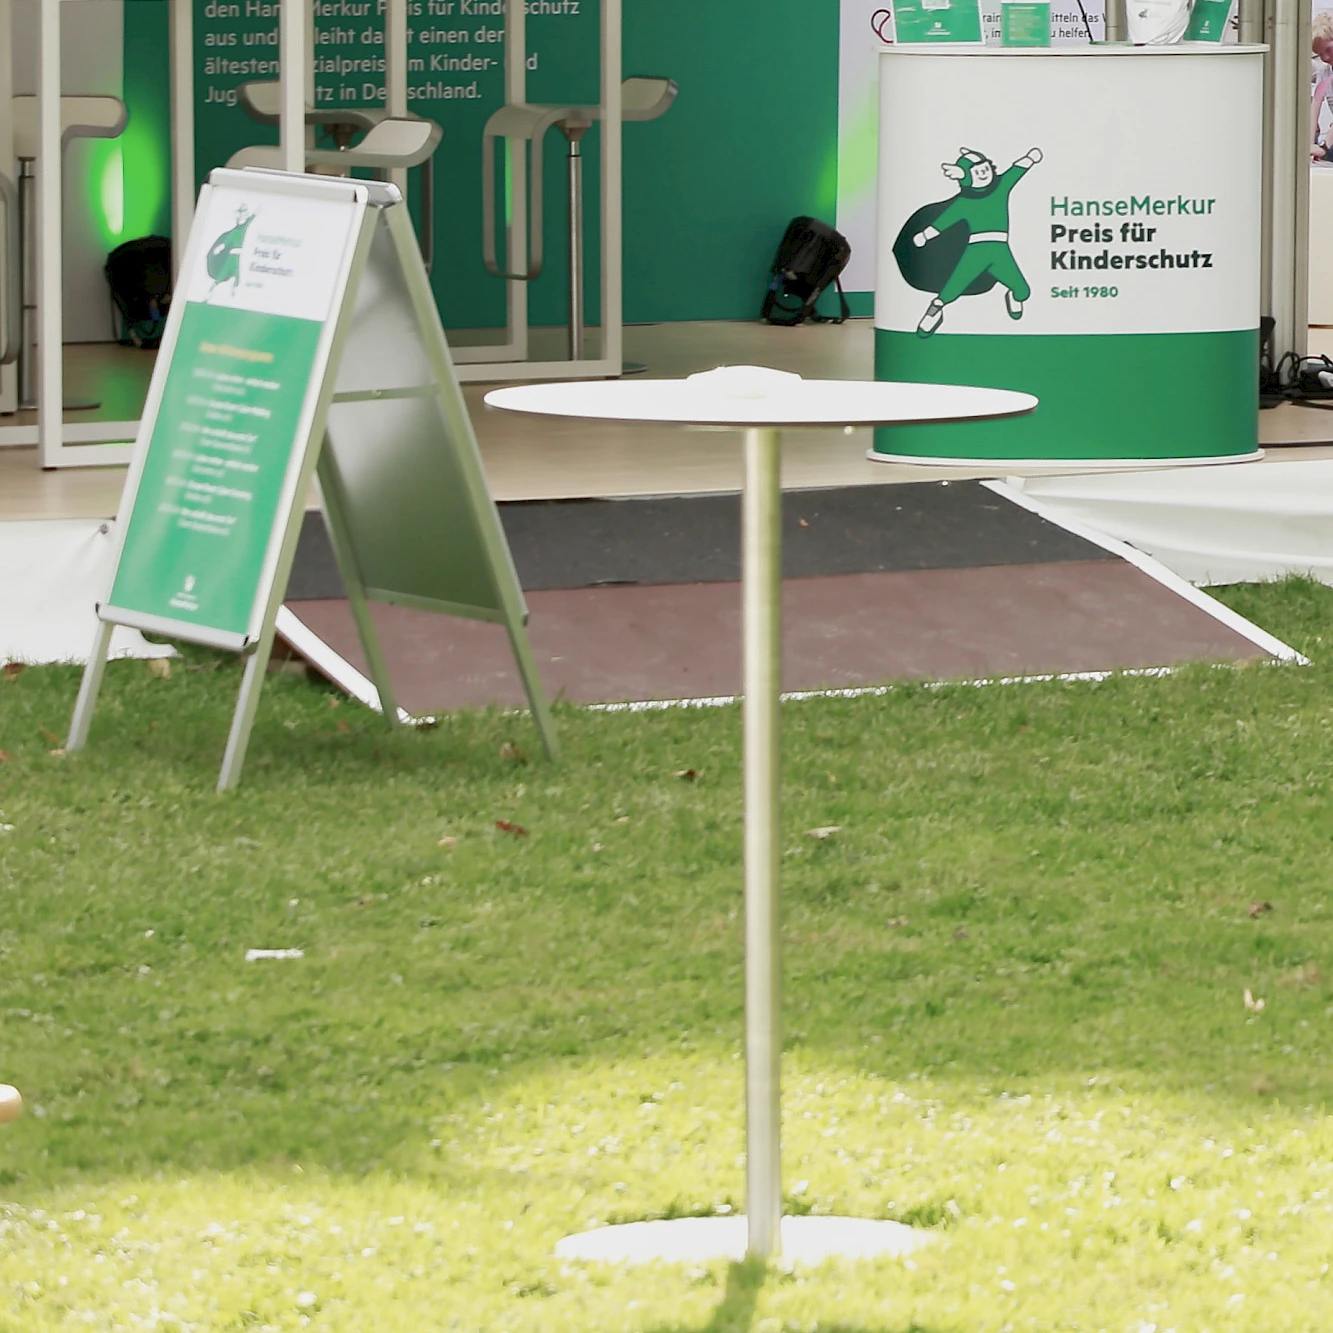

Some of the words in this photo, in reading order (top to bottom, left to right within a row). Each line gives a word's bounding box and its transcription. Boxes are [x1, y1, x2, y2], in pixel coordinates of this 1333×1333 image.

[205, 0, 239, 18] den
[205, 32, 236, 46] aus
[243, 28, 279, 45] und
[419, 27, 468, 44] einen
[474, 25, 505, 43] der
[1058, 28, 1091, 39] helfen
[205, 57, 280, 74] ältesten
[430, 53, 498, 71] Kinder-
[340, 83, 356, 100] in
[362, 81, 482, 100] Deschland.
[1051, 195, 1215, 216] HanseMerkur
[1051, 223, 1113, 242] Preis
[1120, 223, 1156, 242] für
[1052, 249, 1212, 269] Kinderschutz
[1051, 286, 1079, 298] Seit
[1084, 287, 1118, 297] 1980
